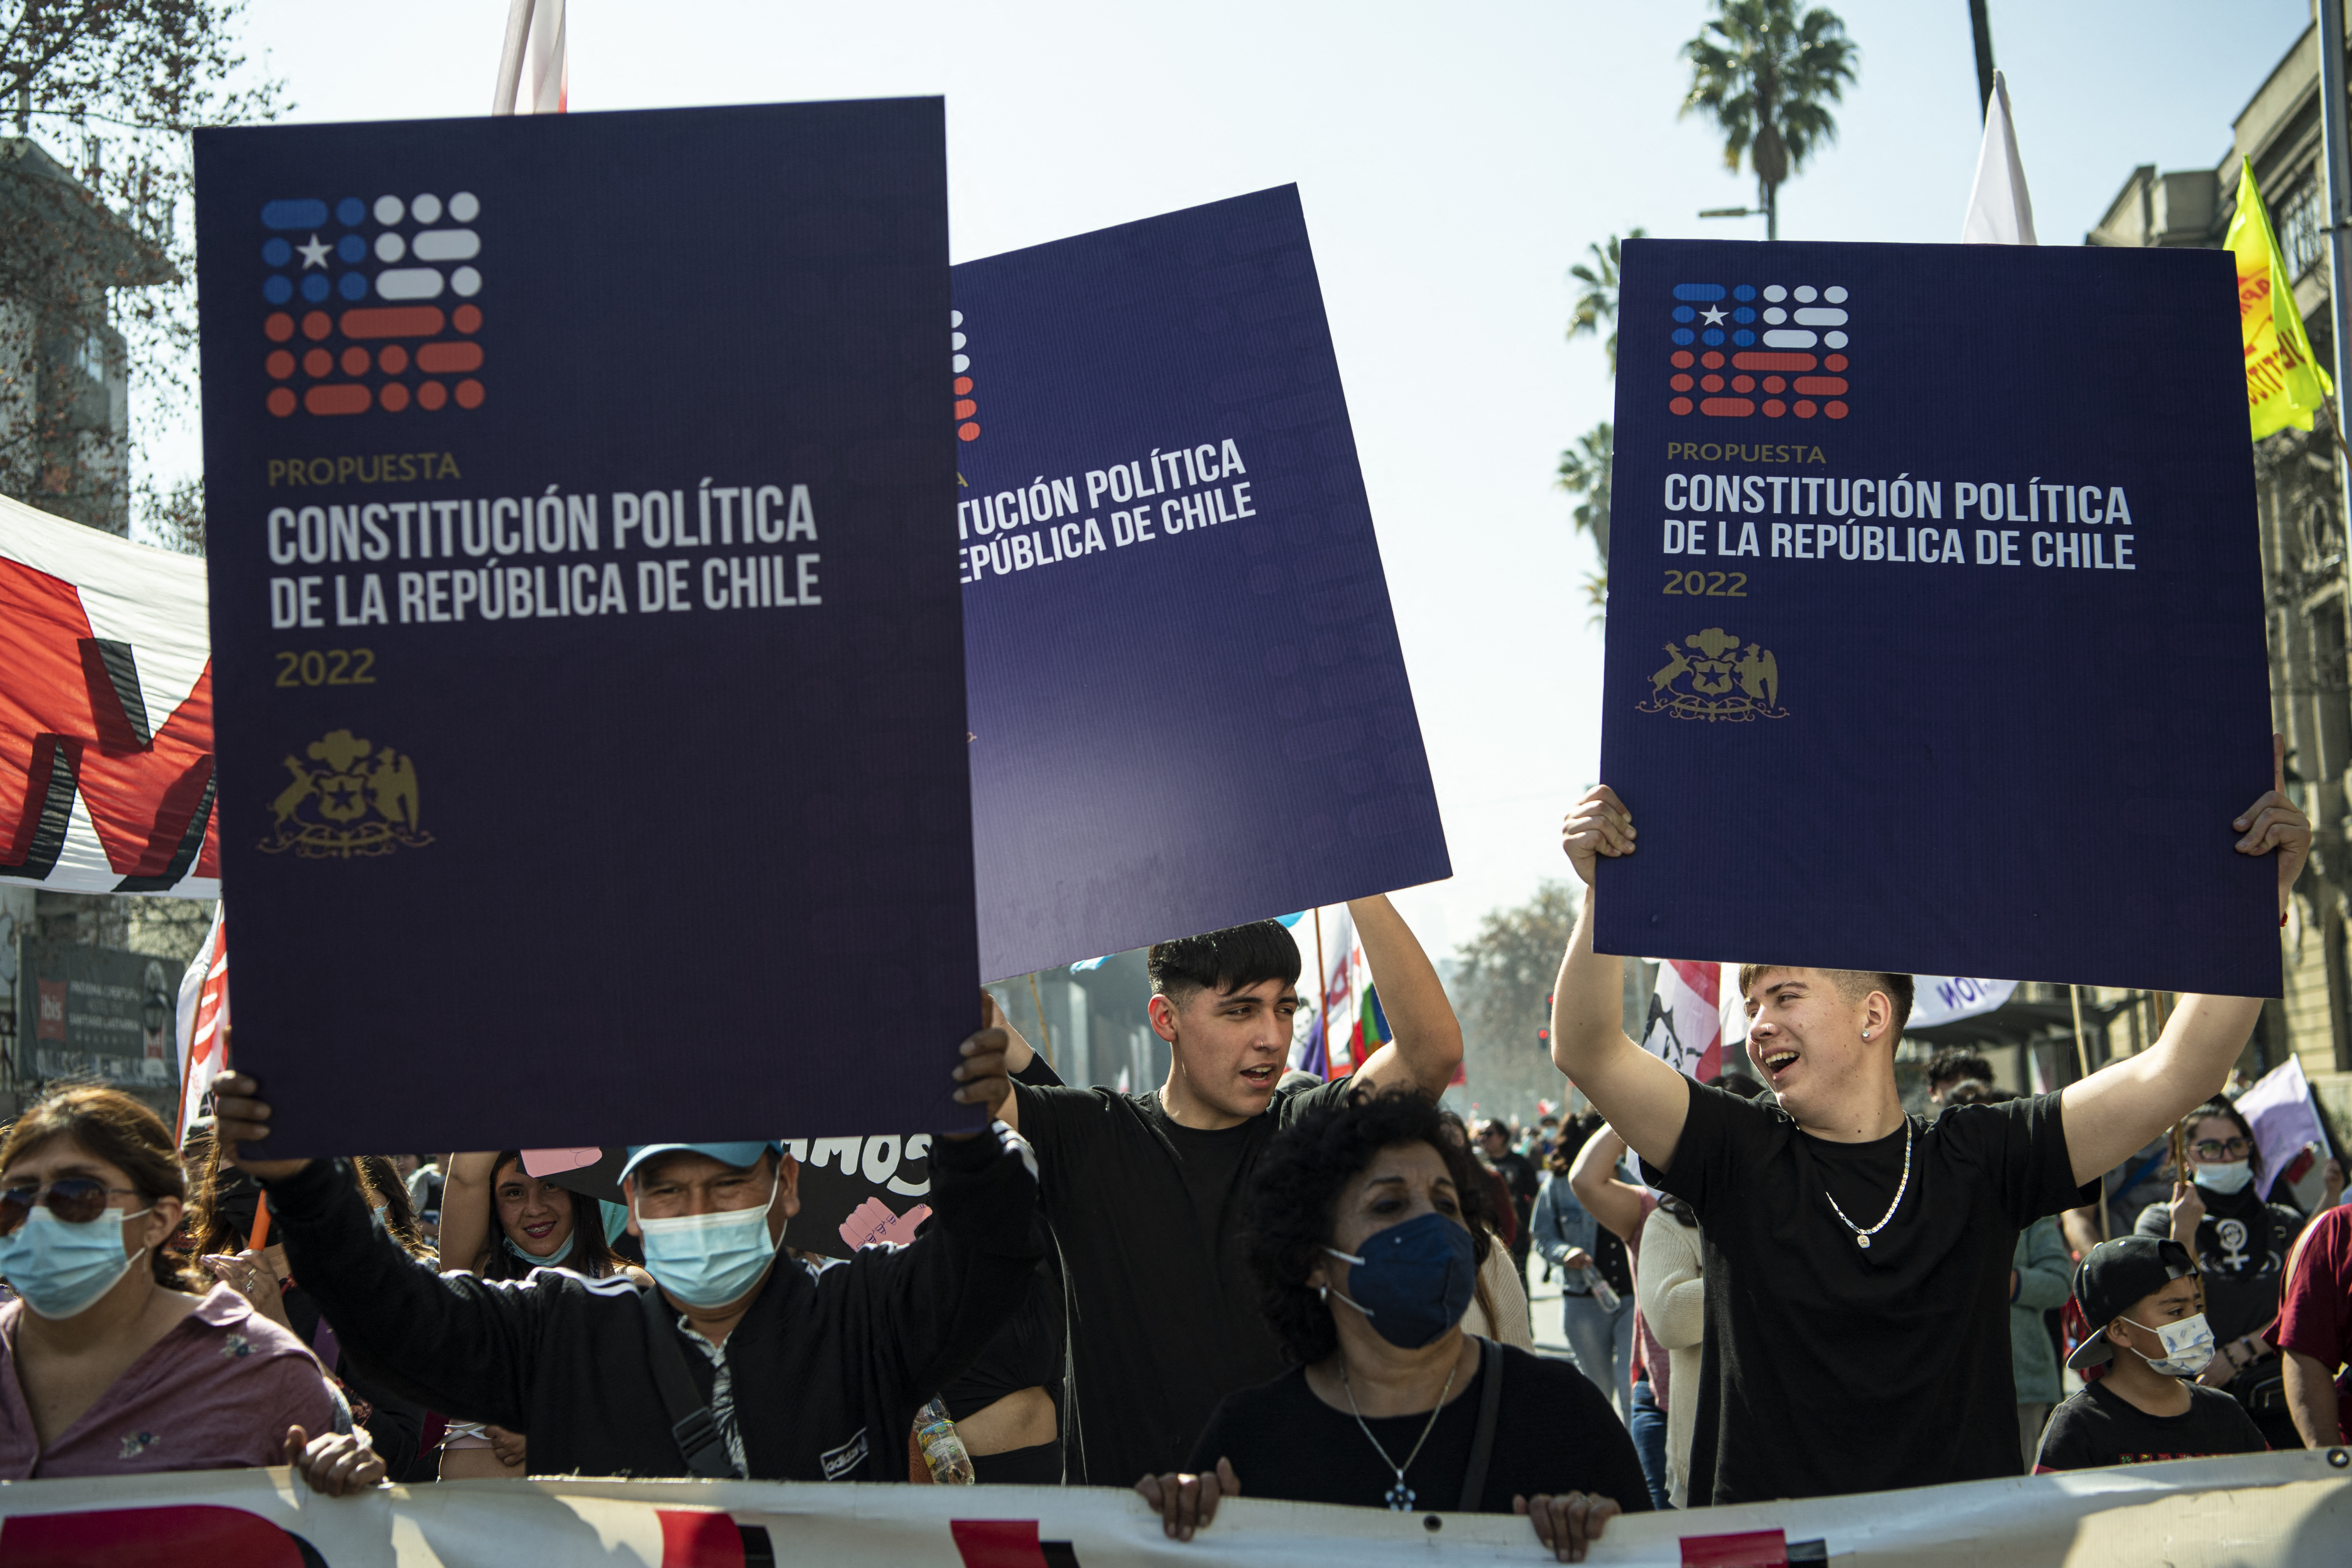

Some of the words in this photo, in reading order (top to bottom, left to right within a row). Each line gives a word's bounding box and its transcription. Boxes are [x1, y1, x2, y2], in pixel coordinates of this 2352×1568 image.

[268, 452, 461, 487] PROPUESTA
[1668, 442, 1827, 464] PROPUESTA
[957, 476, 1079, 540] TUCIÓN
[1085, 438, 1247, 509] POLÍTICA
[1665, 473, 1941, 519] CONSTITUCIÓN
[1955, 477, 2132, 525] POLÍTICA
[267, 484, 599, 565] CONSTITUCIÓN
[612, 476, 818, 550] POLÍTICA
[959, 518, 1107, 584] EPÚBLICA
[1111, 505, 1156, 547] DE
[1161, 482, 1256, 534] CHILE
[1663, 520, 1707, 555] DE
[1718, 521, 1760, 557] LA
[1771, 518, 1965, 564] REPÚBLICA
[1976, 530, 2021, 566] DE
[2032, 531, 2136, 570] CHILE
[270, 577, 325, 629] DE
[335, 573, 389, 626] LA
[398, 558, 628, 624] REPÚBLICA
[637, 559, 692, 613] DE
[702, 553, 822, 611] CHILE
[1663, 570, 1747, 597] 2022
[275, 648, 377, 688] 2022
[41, 994, 63, 1021] ibis
[825, 1446, 859, 1472] adidas
